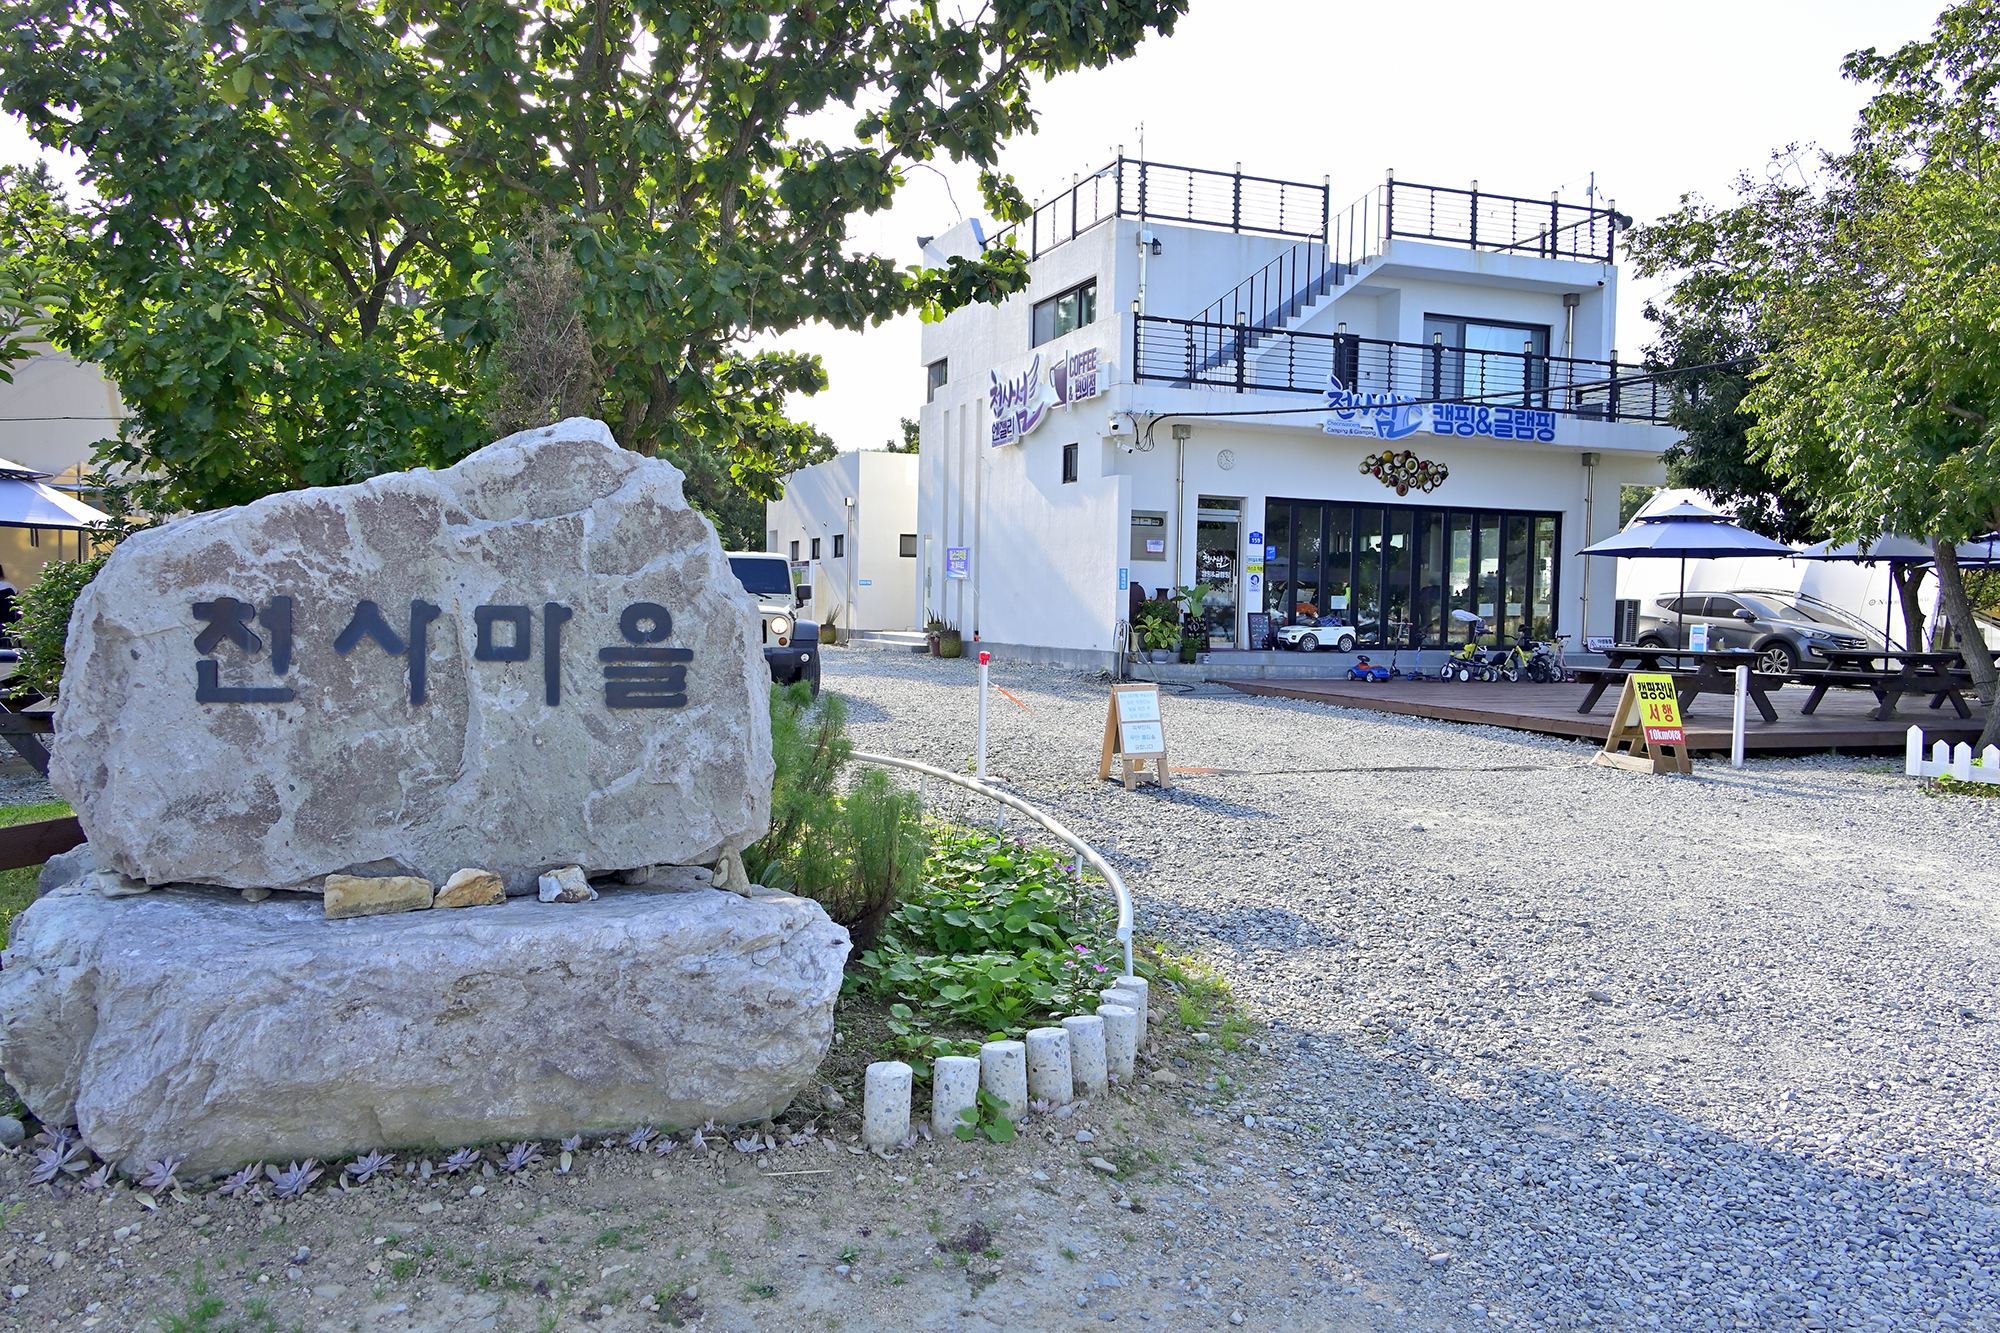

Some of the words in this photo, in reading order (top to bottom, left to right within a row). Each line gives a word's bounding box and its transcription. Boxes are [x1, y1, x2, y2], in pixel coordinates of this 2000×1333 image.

[1069, 347, 1097, 378] COFFEE
[989, 362, 1044, 434] 천사섬
[1074, 373, 1097, 400] 편의점
[1326, 427, 1348, 435] Camping
[1353, 429, 1377, 437] Glamping
[1431, 403, 1556, 442] 캠핑&글램핑
[193, 595, 694, 708] 천사마을
[1637, 682, 1675, 700] 캠핑장내
[1649, 703, 1674, 722] 서행
